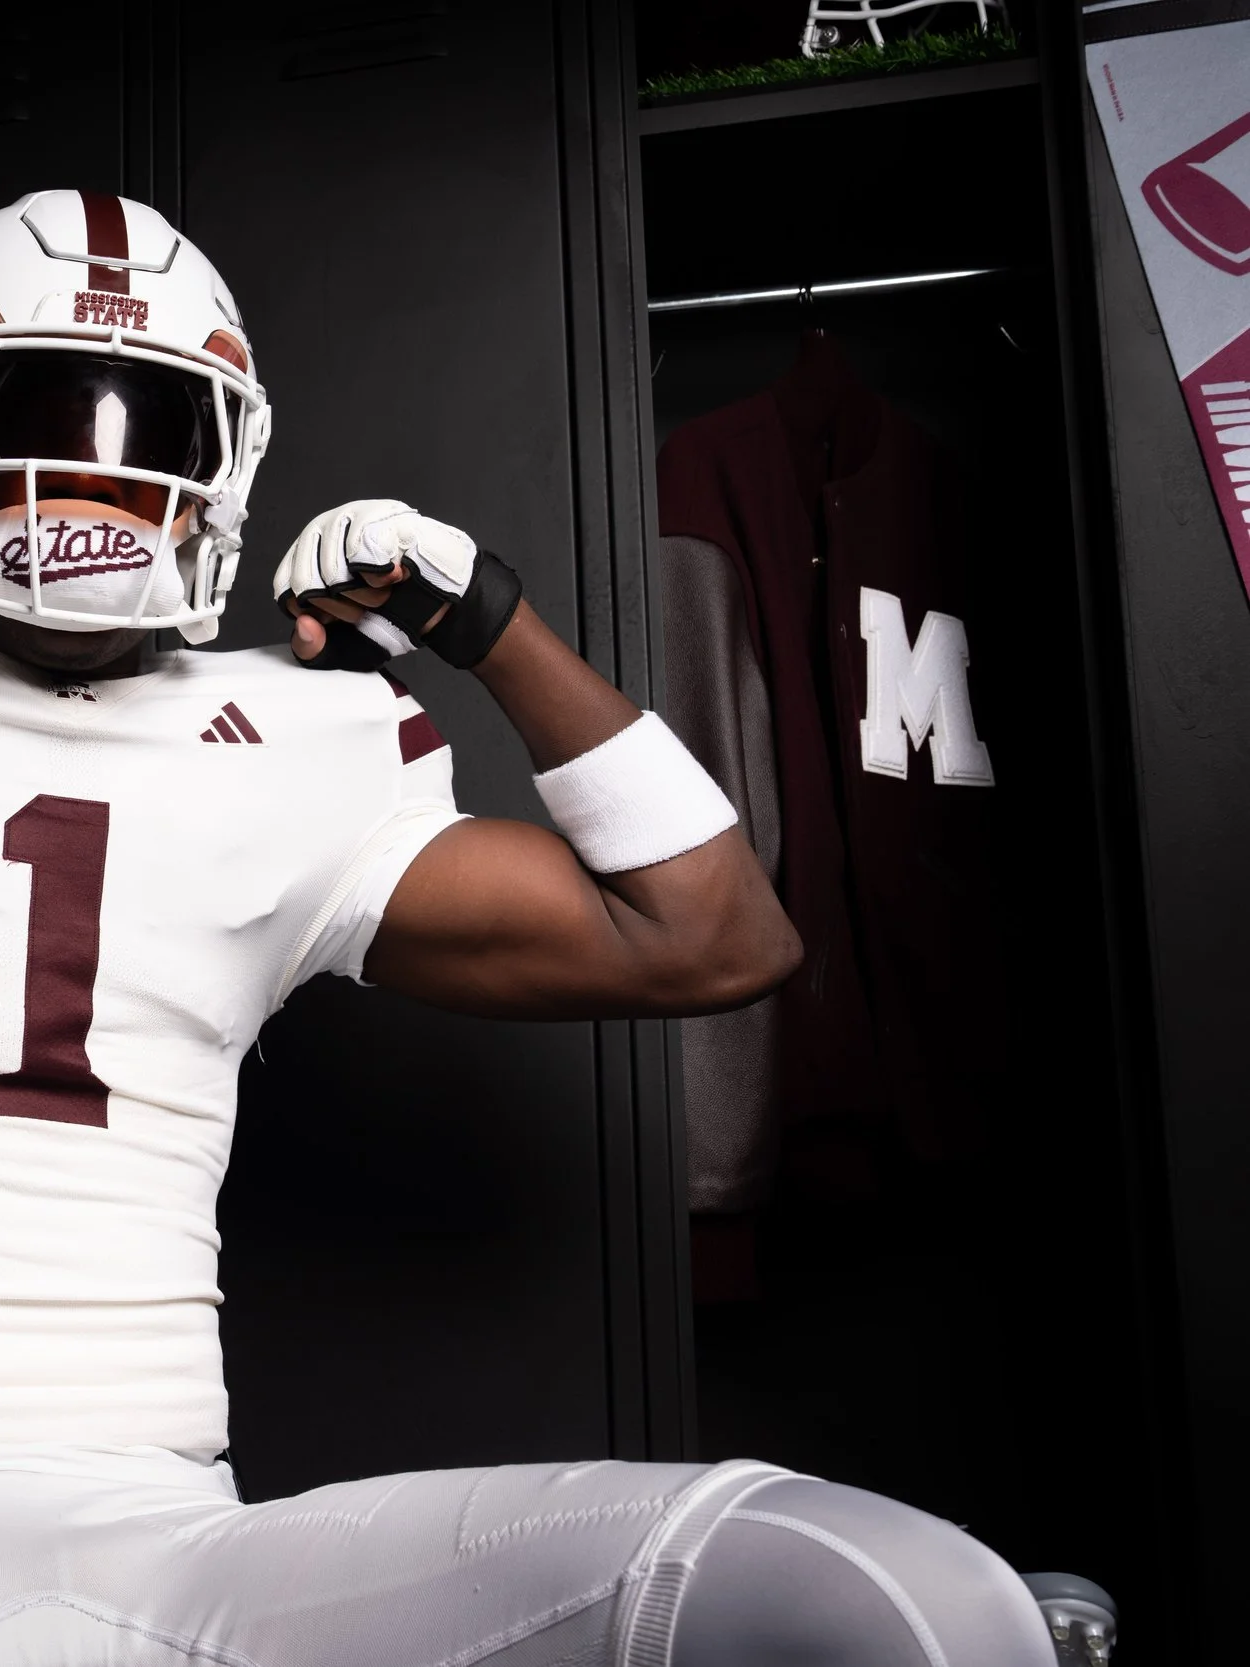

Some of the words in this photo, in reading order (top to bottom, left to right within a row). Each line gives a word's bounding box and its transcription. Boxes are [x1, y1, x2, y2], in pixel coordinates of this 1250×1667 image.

[74, 291, 149, 312] MISSISSIPPI
[73, 302, 148, 332] STATE
[860, 585, 997, 787] M
